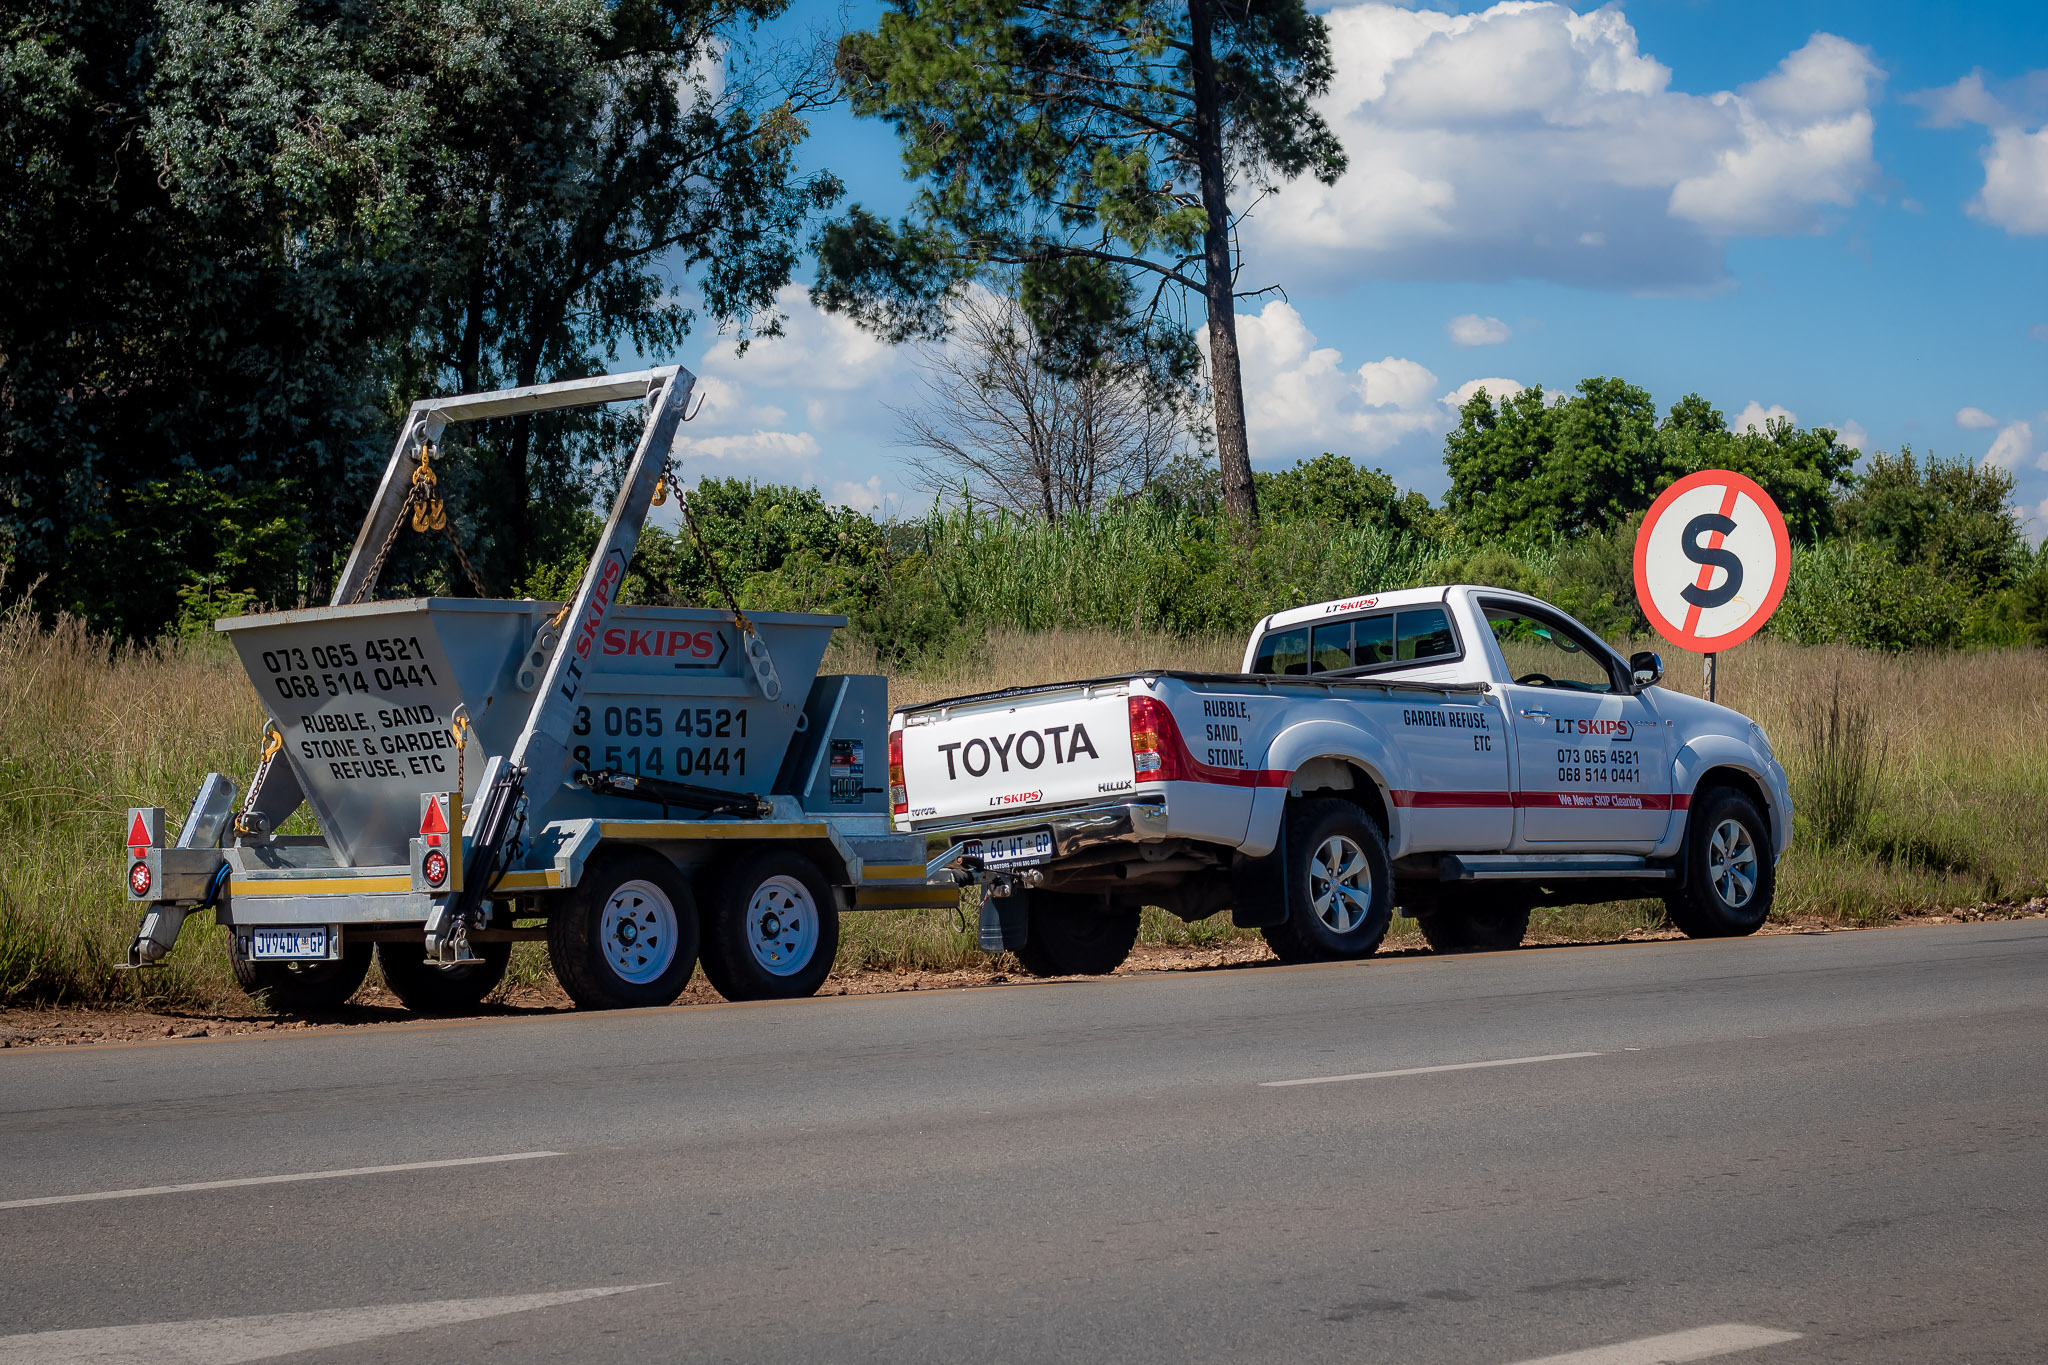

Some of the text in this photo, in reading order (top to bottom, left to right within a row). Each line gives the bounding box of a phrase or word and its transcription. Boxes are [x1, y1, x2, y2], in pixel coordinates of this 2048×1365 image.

[1680, 513, 1744, 608] S
[1339, 598, 1375, 611] SKIPS
[561, 656, 583, 702] LT
[576, 558, 619, 660] SKIPS
[602, 628, 714, 659] SKIPS
[262, 636, 425, 673] 073 065 4521
[275, 664, 438, 699] 068 514 0441
[300, 704, 443, 734] RUBBLE, SAND,
[1203, 700, 1251, 722] RUBBLE,
[1403, 709, 1490, 732] GARDEN REFUSE,
[604, 706, 663, 737] 065
[674, 708, 748, 738] 4521
[1555, 719, 1628, 736] LT SKIPS
[300, 728, 458, 760] STONE & GARDEN
[1206, 724, 1242, 745] SAND,
[1473, 735, 1491, 751] ETC
[604, 746, 665, 777] 514
[675, 747, 747, 777] 0441
[938, 723, 1099, 780] TOYOTA
[1207, 748, 1249, 769] STONE,
[1557, 749, 1639, 765] 073 065 4521
[328, 754, 446, 780] REFUSE, ETC
[1558, 768, 1639, 783] 068 514 0441
[1098, 780, 1132, 793] HILUX
[989, 790, 1039, 806] LT SKIPS
[1558, 794, 1642, 809] We Never SKIP Cleaning
[911, 807, 937, 817] TOYOTA
[1036, 834, 1049, 852] GP
[258, 932, 324, 953] JV94DK GP
